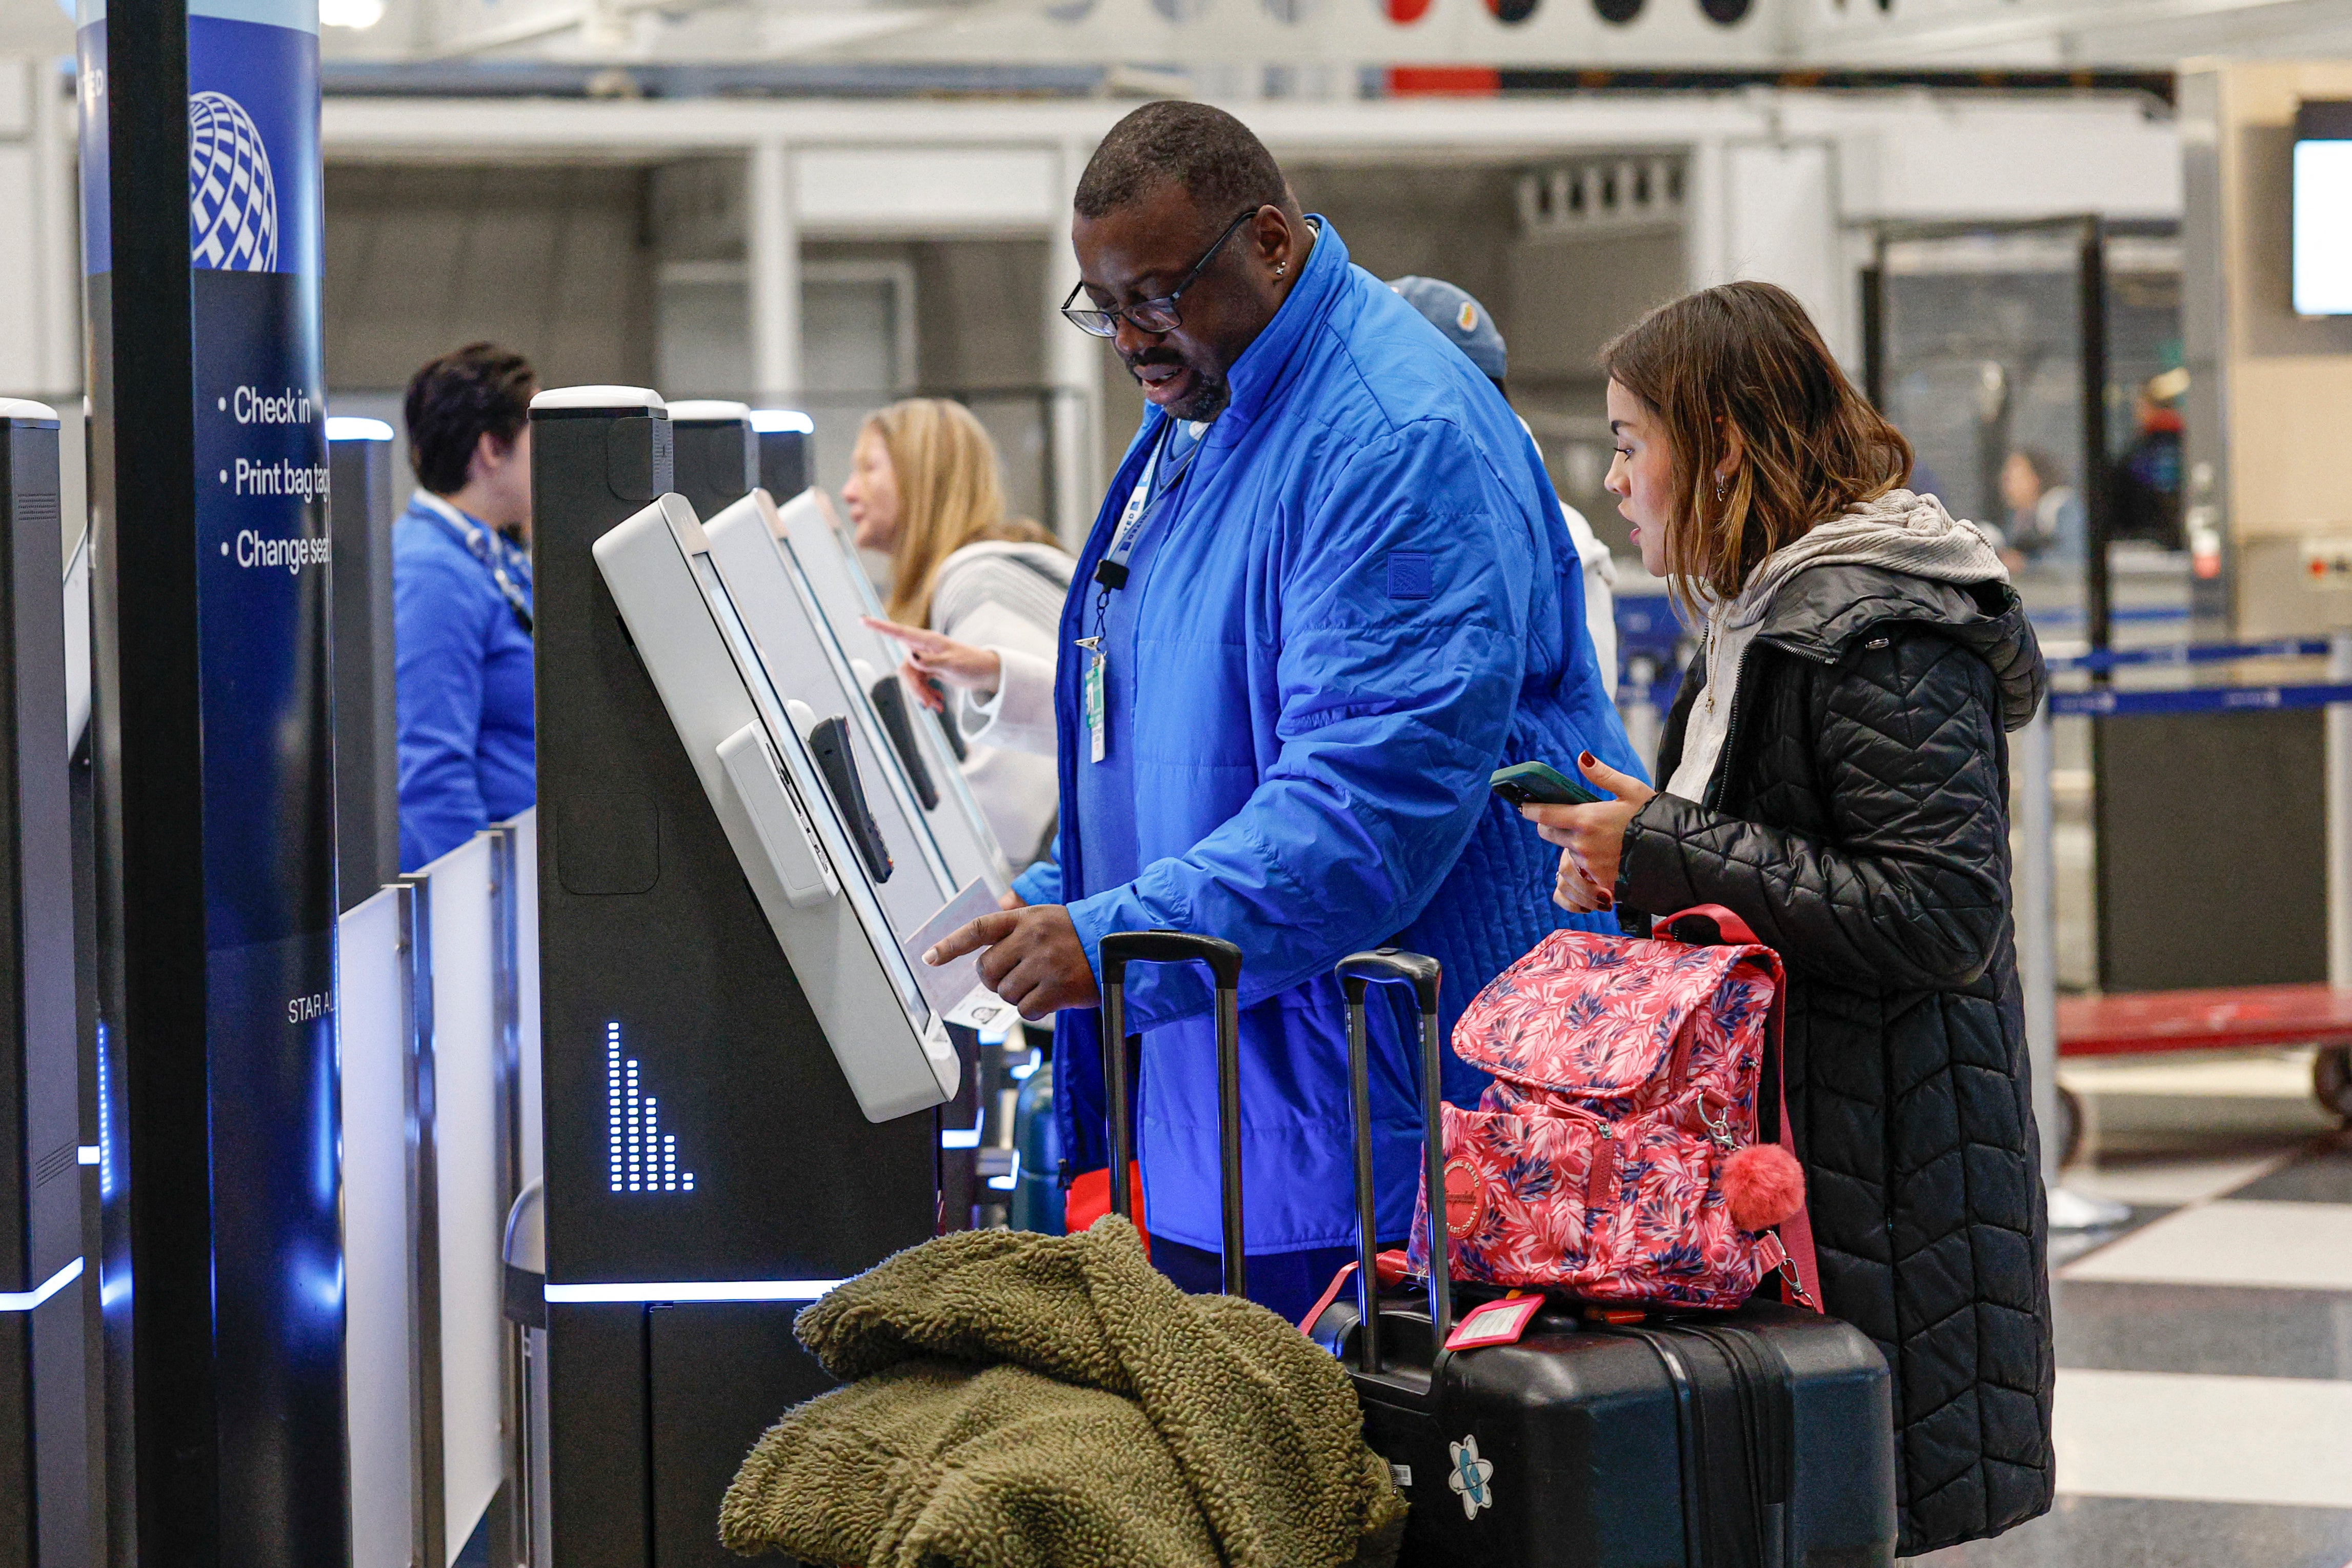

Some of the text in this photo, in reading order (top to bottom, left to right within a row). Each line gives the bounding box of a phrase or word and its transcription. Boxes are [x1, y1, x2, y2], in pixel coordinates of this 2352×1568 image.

[234, 385, 311, 424] Check in
[235, 457, 282, 496] Print
[284, 457, 312, 503] bag
[1122, 513, 1134, 535] TED
[237, 529, 308, 575] Change
[288, 990, 335, 1023] STAR AL
